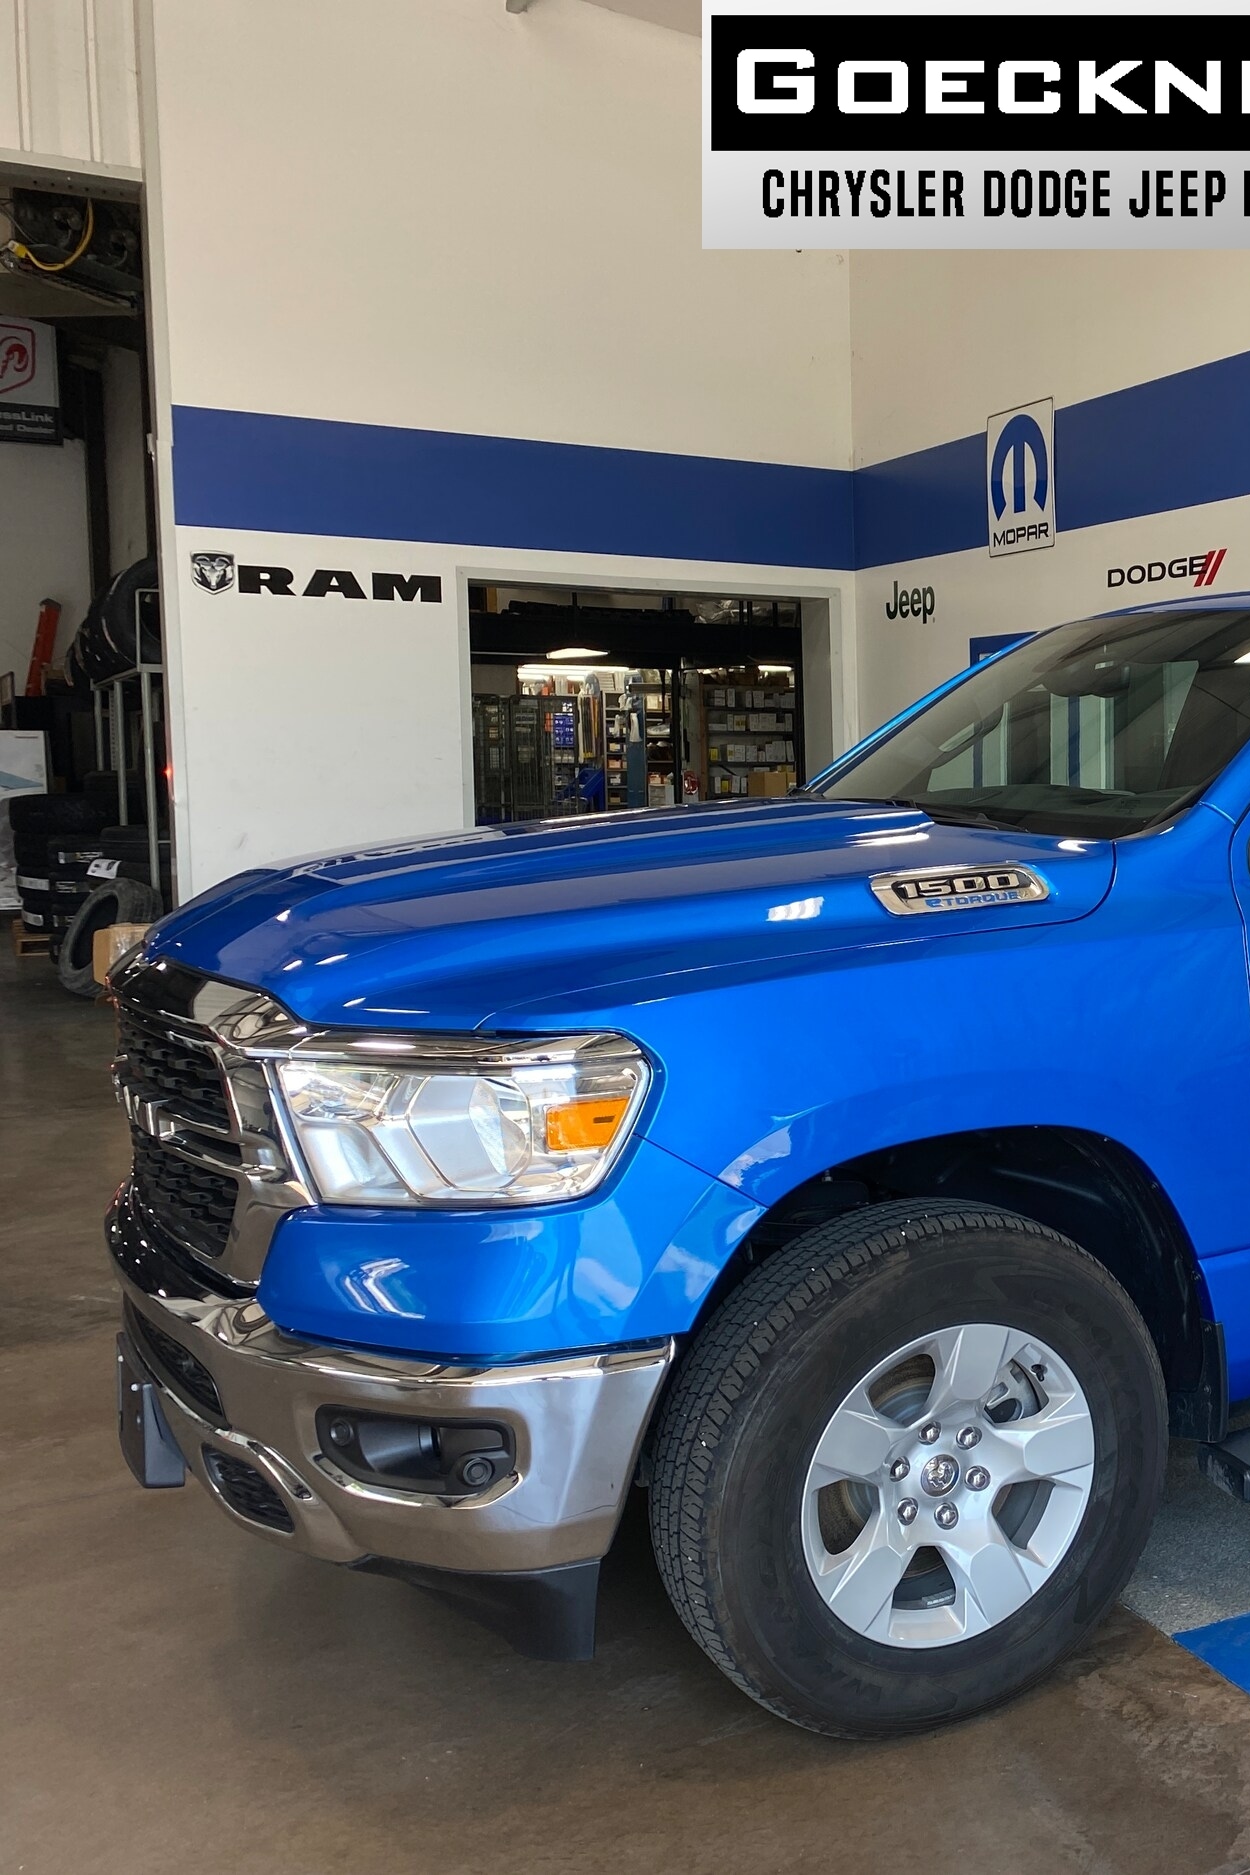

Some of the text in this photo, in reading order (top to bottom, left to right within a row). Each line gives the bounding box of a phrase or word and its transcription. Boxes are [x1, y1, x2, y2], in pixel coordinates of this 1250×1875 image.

[0, 411, 54, 424] ssLink
[993, 521, 1050, 548] MOPAR
[237, 565, 443, 604] RAM
[1107, 554, 1208, 588] DODGE
[885, 580, 936, 625] Jeep
[900, 872, 1020, 900] 1500
